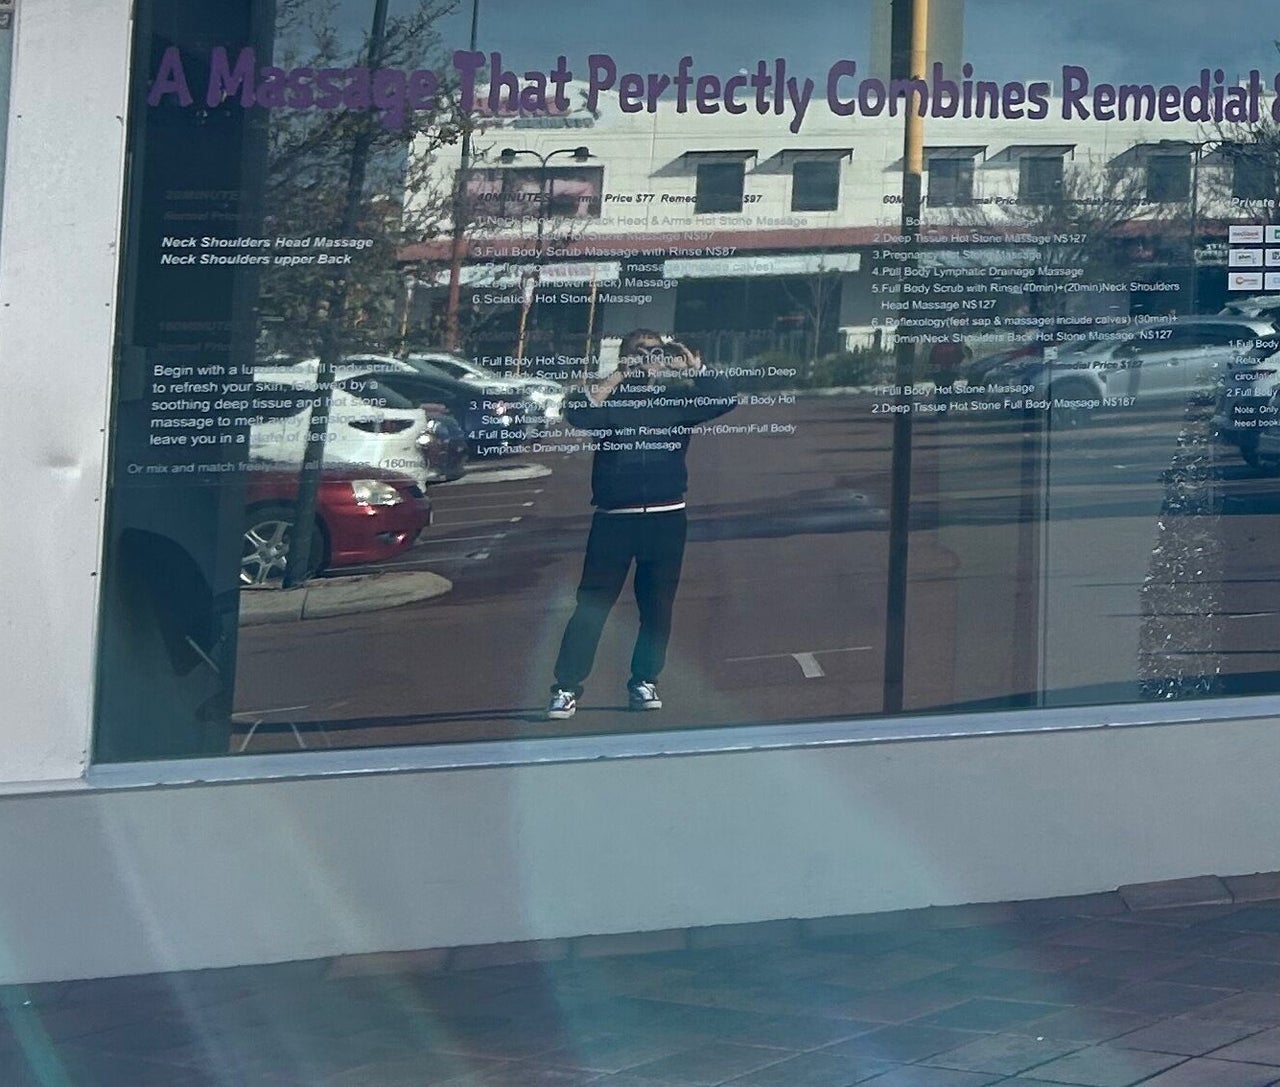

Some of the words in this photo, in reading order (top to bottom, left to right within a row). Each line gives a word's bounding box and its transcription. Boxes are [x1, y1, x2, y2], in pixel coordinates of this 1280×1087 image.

[148, 45, 194, 108] A
[205, 45, 438, 130] Massage
[453, 49, 574, 113] That
[588, 52, 815, 135] Perfectly
[826, 59, 1050, 124] Combines
[1061, 64, 1259, 124] Remedial
[1231, 197, 1275, 208] Private
[162, 237, 197, 248] Neck
[200, 237, 271, 248] Shoulders
[275, 237, 310, 248] Head
[313, 237, 374, 250] Massage
[512, 247, 543, 258] Body
[546, 246, 579, 257] Scrub
[585, 246, 640, 259] Massage
[642, 247, 666, 256] with
[161, 254, 196, 265] Neck
[200, 254, 270, 265] Shoulders
[274, 256, 313, 267] upper
[317, 254, 352, 265] Back
[881, 300, 909, 310] Head
[912, 300, 960, 311] Massage
[154, 365, 193, 378] Begin
[197, 364, 225, 375] with
[228, 366, 238, 375] a
[152, 384, 166, 393] to
[170, 382, 219, 393] refresh
[222, 383, 253, 395] your
[151, 400, 211, 412] soothing
[214, 399, 249, 411] deep
[252, 399, 292, 409] tissue
[296, 398, 322, 408] and
[913, 402, 947, 412] Tissue
[950, 401, 969, 411] Hot
[1026, 399, 1051, 410] Body
[1054, 398, 1100, 410] Massage
[151, 416, 214, 429] massage
[217, 416, 231, 427] to
[150, 434, 187, 445] leave
[191, 435, 217, 447] you
[220, 433, 232, 443] in
[236, 434, 245, 443] a
[533, 443, 579, 455] Drainage
[582, 442, 601, 451] Hot
[603, 441, 634, 451] Stone
[635, 441, 682, 452] Massage
